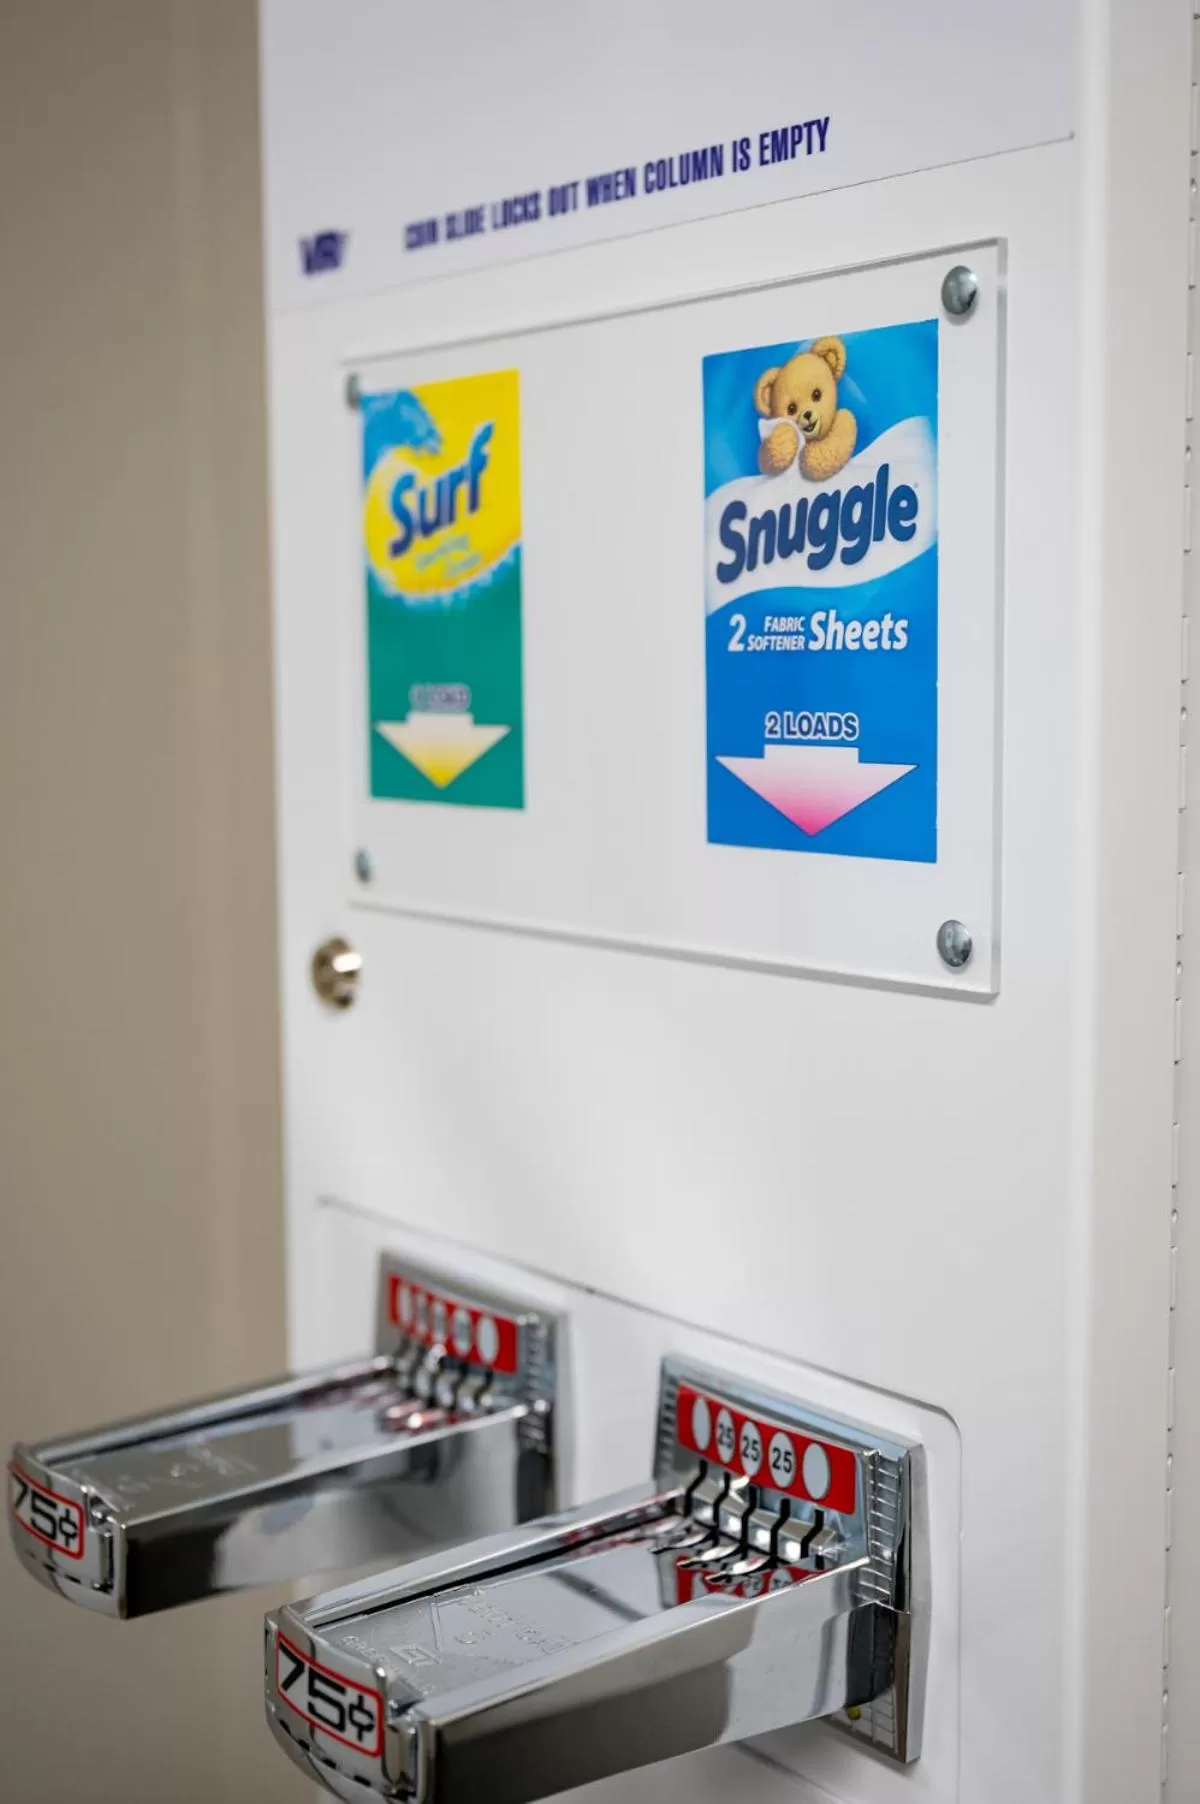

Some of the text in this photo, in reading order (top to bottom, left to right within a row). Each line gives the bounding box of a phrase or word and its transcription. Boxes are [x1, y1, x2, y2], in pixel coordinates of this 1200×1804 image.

[585, 166, 637, 207] WHEN
[644, 143, 724, 194] COLUMN
[731, 136, 751, 173] IS
[759, 116, 831, 167] EMPTY
[388, 420, 496, 559] Surf
[716, 462, 919, 585] Snuggle
[727, 608, 909, 653] 2 FABRIC SOFTENER Sheets
[765, 711, 860, 741] 2 LOADS
[718, 1422, 793, 1473] 25 25 25
[278, 1641, 375, 1743] 75¢
